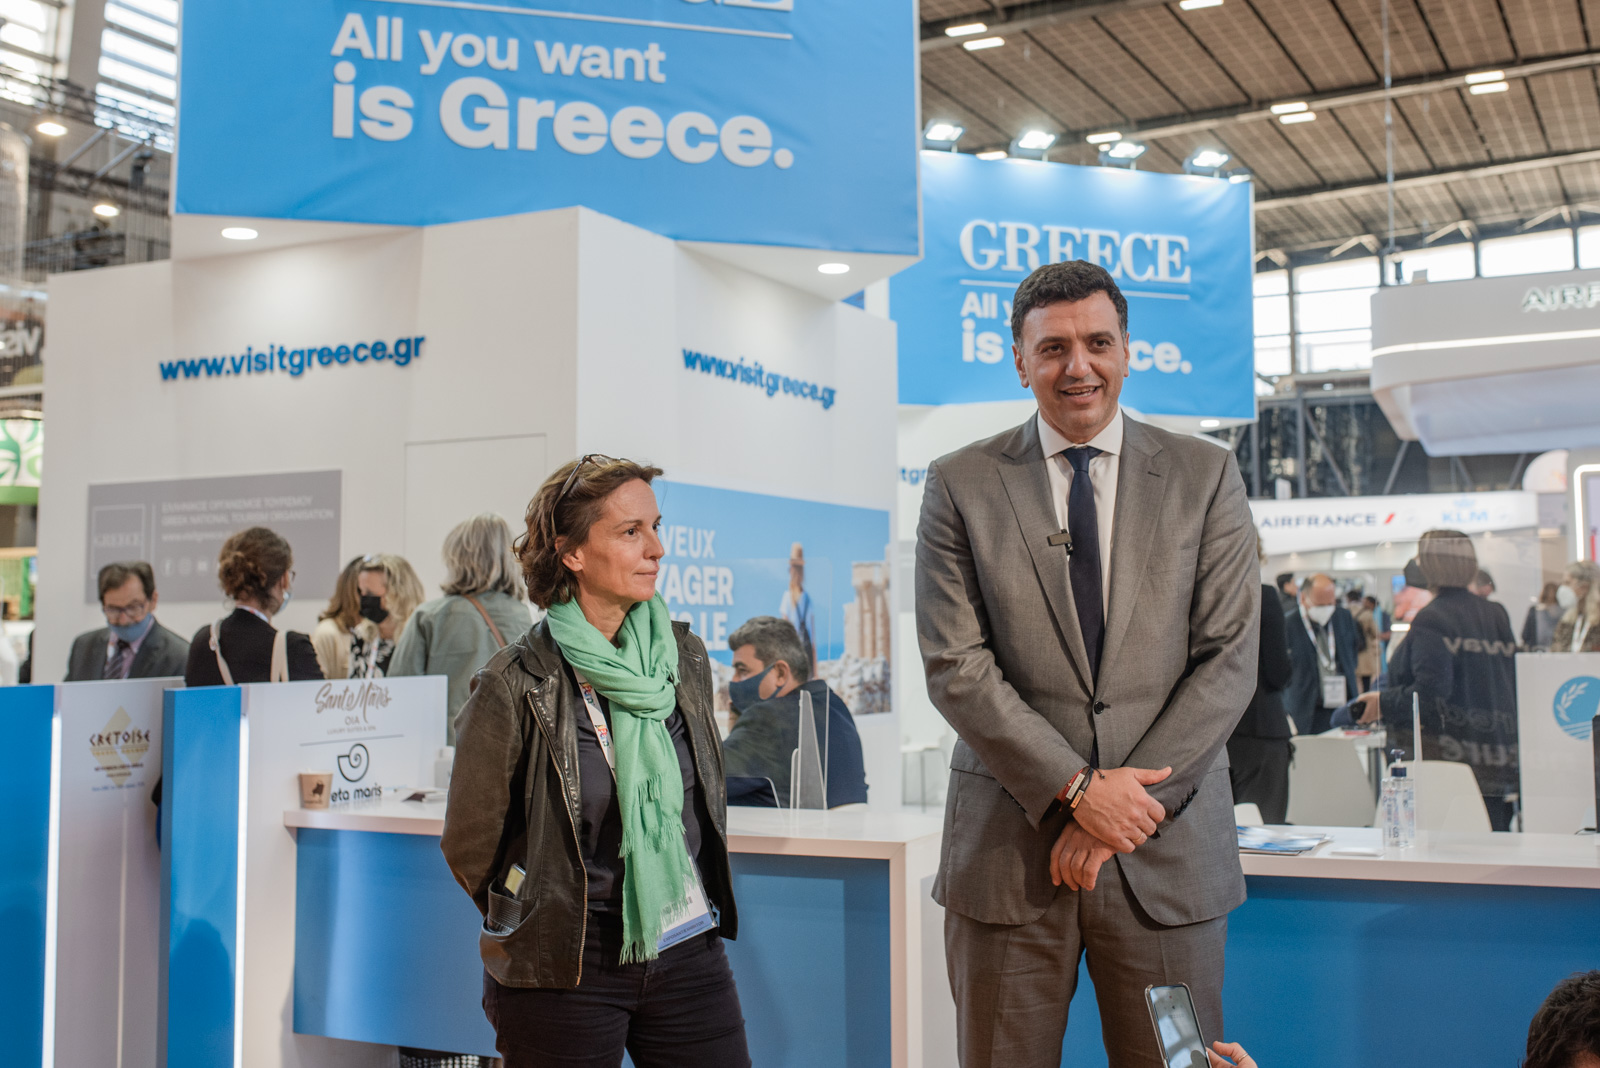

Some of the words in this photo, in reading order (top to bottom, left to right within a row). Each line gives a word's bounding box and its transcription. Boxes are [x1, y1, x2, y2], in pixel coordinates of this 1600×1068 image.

[331, 13, 403, 61] All
[418, 29, 519, 75] you
[534, 40, 667, 83] want
[332, 61, 414, 141] is
[439, 76, 794, 169] Greece.
[959, 219, 1192, 283] GREECE
[960, 292, 998, 319] All
[159, 335, 425, 382] www.visitgreece.gr
[961, 319, 1004, 364] is
[681, 348, 836, 411] www.visitgreece.gr
[1260, 512, 1377, 529] AIRFRANCE
[1441, 510, 1489, 523] KLM
[660, 526, 716, 559] VEUX
[655, 563, 734, 606] YAGER
[89, 730, 151, 747] CRETOISE
[331, 787, 350, 802] eta
[353, 783, 382, 799] maris
